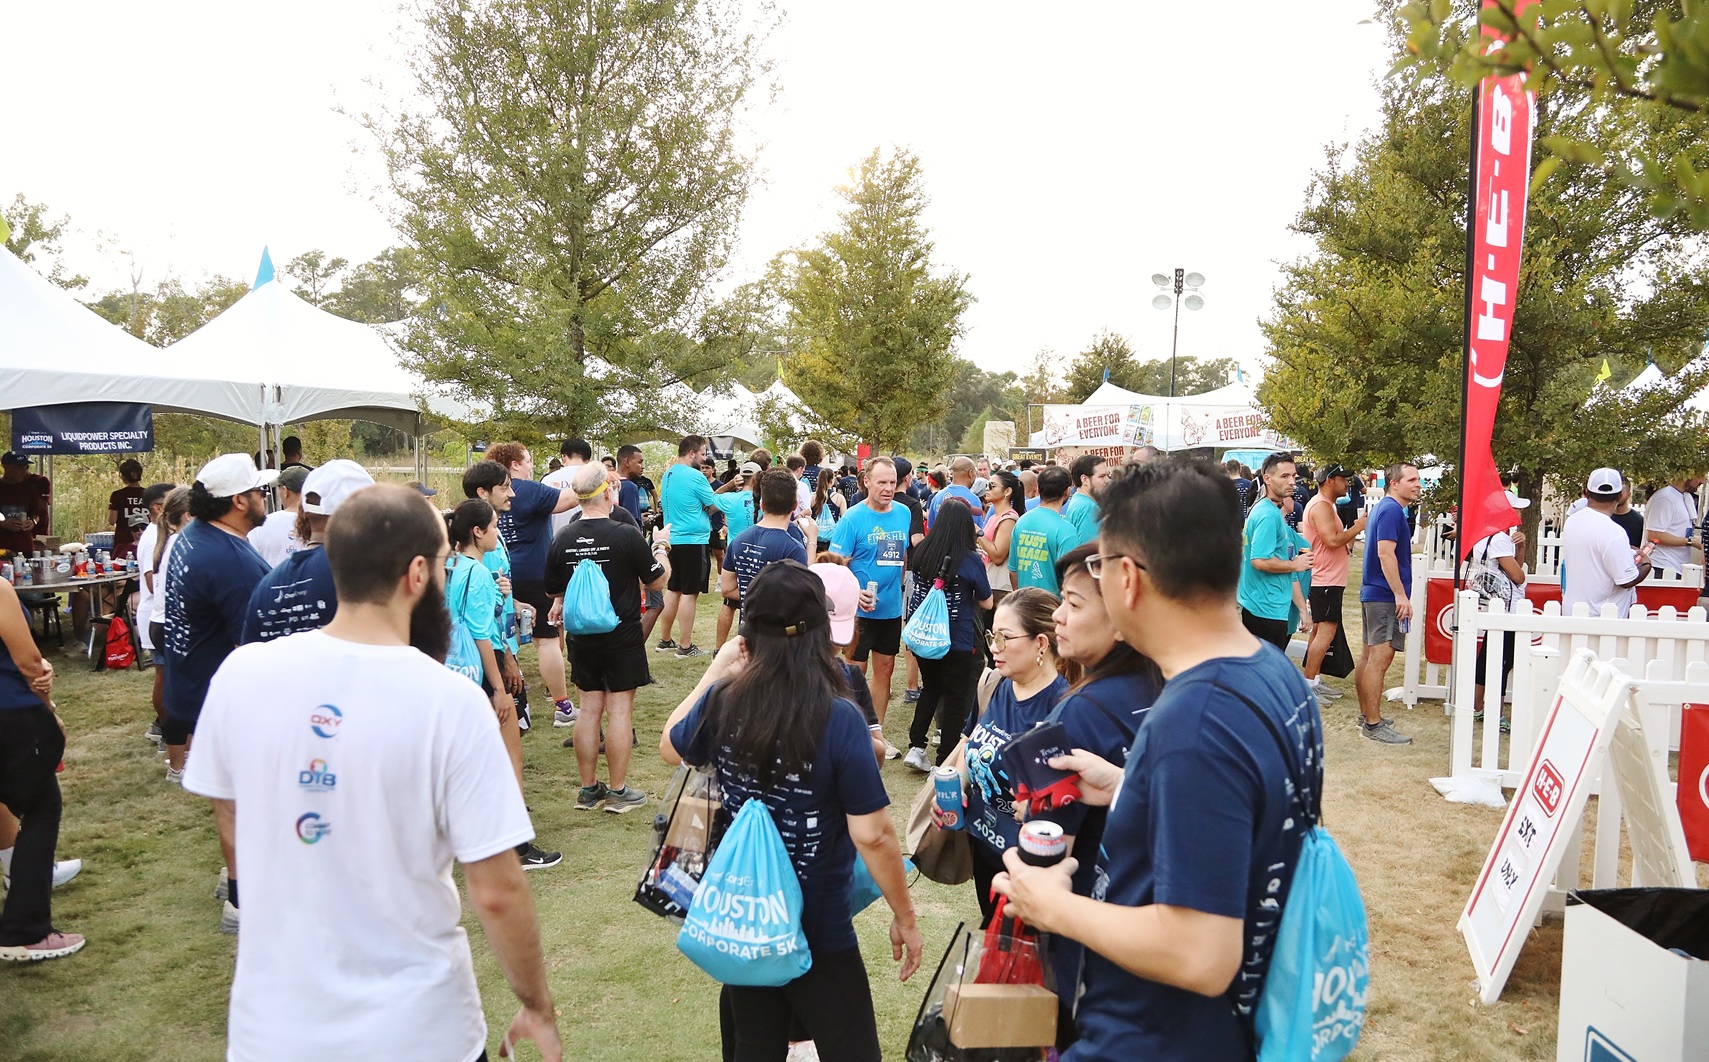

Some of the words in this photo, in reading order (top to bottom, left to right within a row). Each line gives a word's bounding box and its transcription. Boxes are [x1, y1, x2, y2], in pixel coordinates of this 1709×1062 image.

[1076, 418, 1082, 429] A
[1082, 415, 1103, 428] BEER
[1104, 413, 1120, 425] FOR
[1216, 418, 1222, 430] A
[1222, 415, 1244, 429] BEER
[22, 434, 53, 443] HOUSTON
[60, 432, 109, 442] LIQUIDPOWER
[109, 430, 148, 440] SPECIALTY
[1079, 424, 1120, 440] EVERYONE
[1219, 425, 1262, 441] EVERYONE
[79, 441, 117, 450] PRODUCTS
[117, 441, 133, 450] INC.
[1109, 446, 1124, 456] FOR
[1018, 533, 1047, 548] JUST
[882, 551, 900, 559] 4912
[1017, 545, 1049, 562] LEASE
[1018, 559, 1032, 571] IT
[310, 714, 342, 727] OXY
[968, 723, 1006, 752] HOUST
[298, 770, 336, 787] DTB
[973, 818, 1006, 850] 4028
[776, 937, 798, 956] 5K
